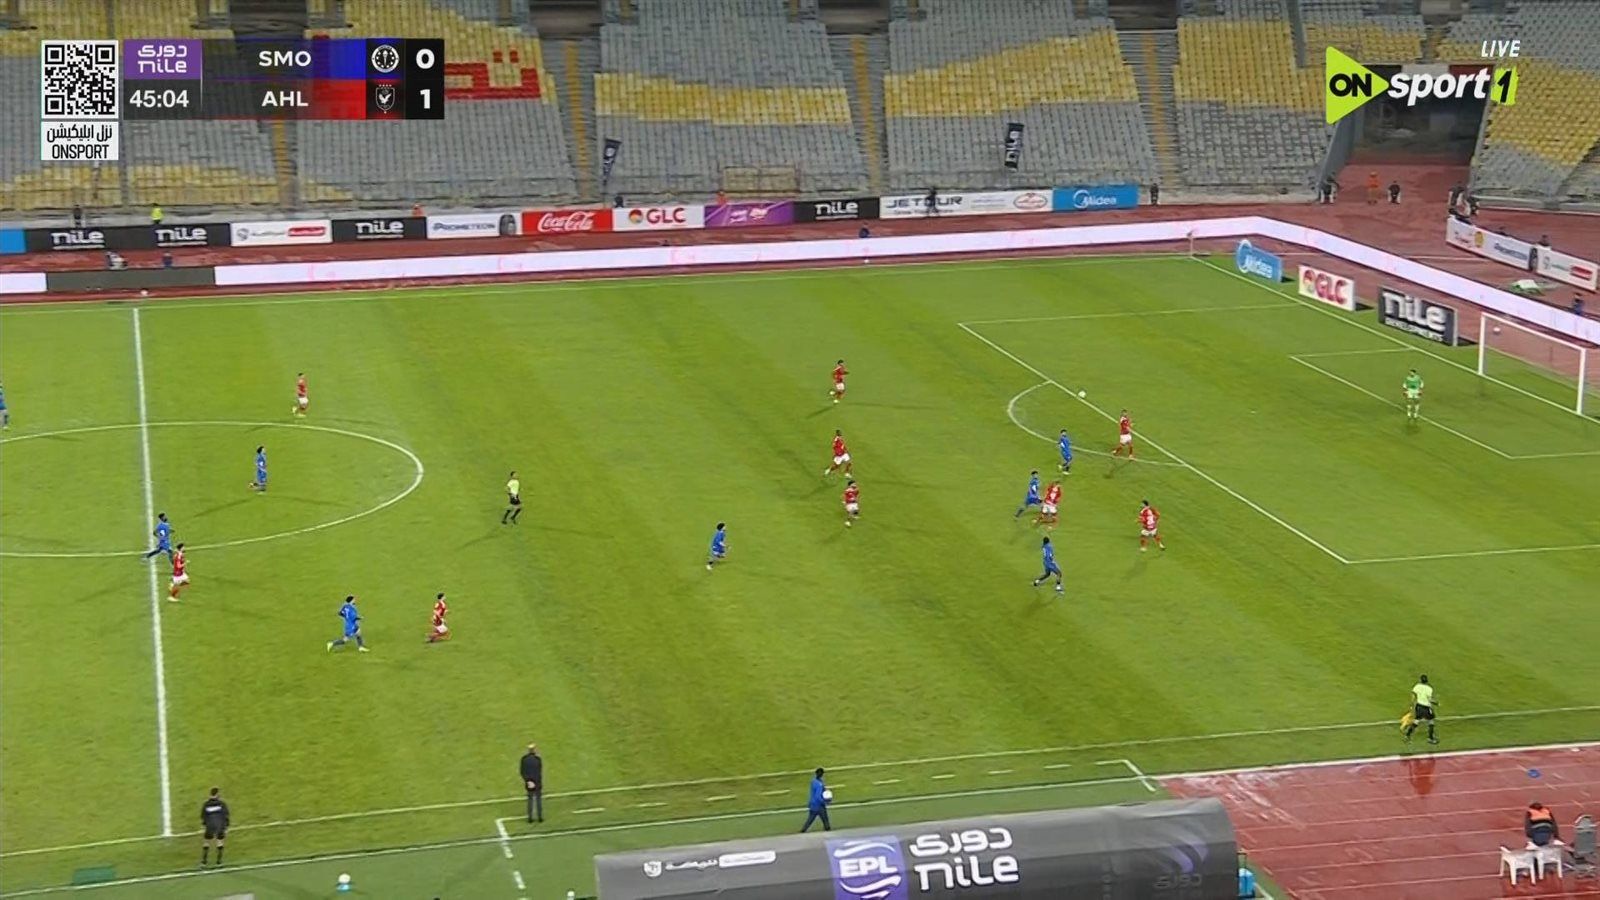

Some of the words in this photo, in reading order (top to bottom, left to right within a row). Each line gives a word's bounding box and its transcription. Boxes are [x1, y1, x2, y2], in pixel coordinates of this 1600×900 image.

[1080, 194, 1118, 207] Midea
[646, 207, 686, 224] GLC
[1314, 273, 1348, 305] GLC
[838, 855, 898, 878] EPL
